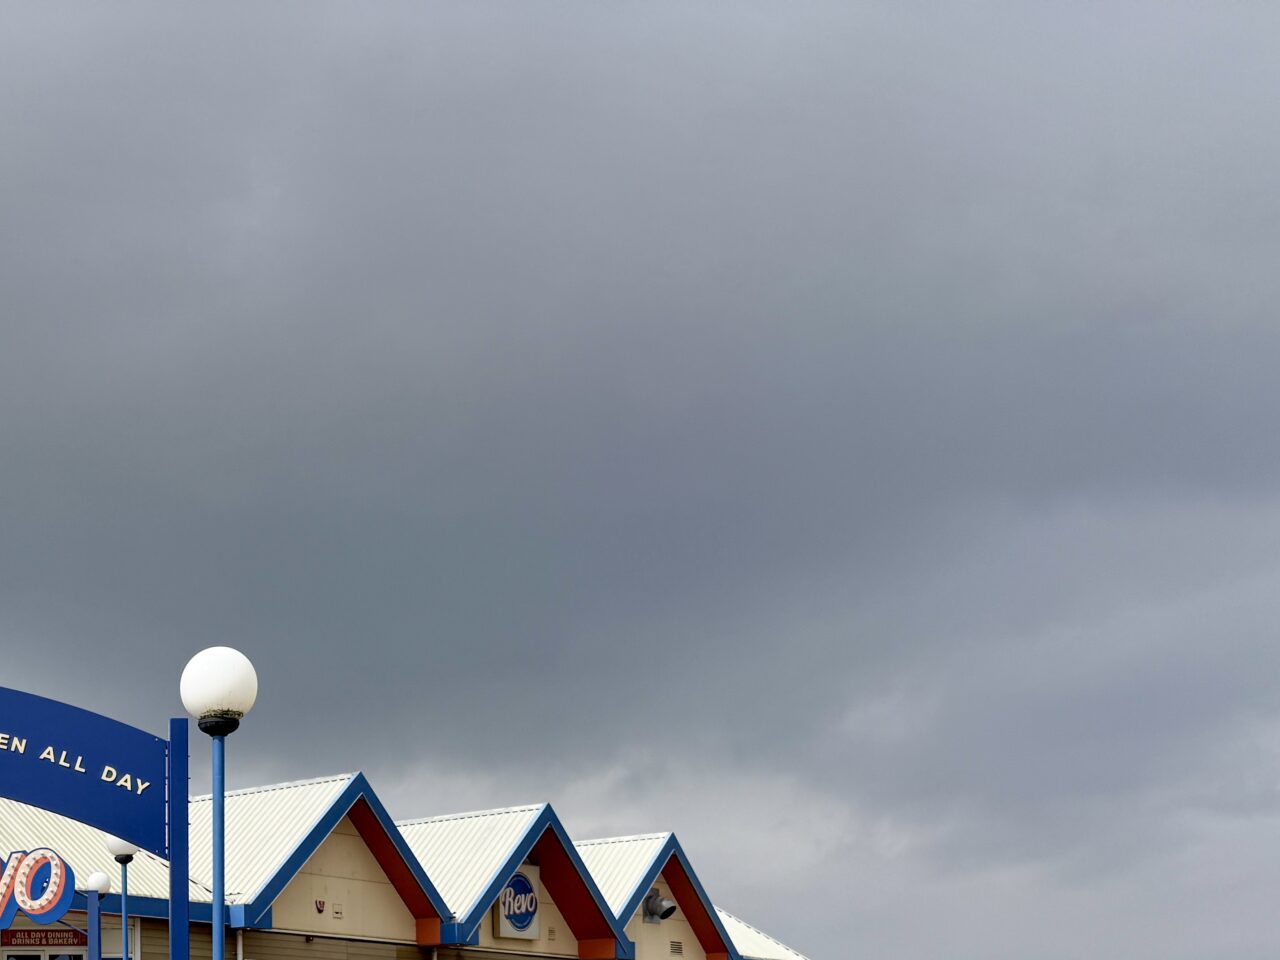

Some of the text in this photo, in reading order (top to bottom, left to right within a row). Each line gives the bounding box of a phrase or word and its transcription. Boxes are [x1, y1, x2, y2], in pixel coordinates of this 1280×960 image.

[39, 746, 86, 773] ALL
[100, 765, 150, 795] DAY
[501, 887, 536, 916] Revo
